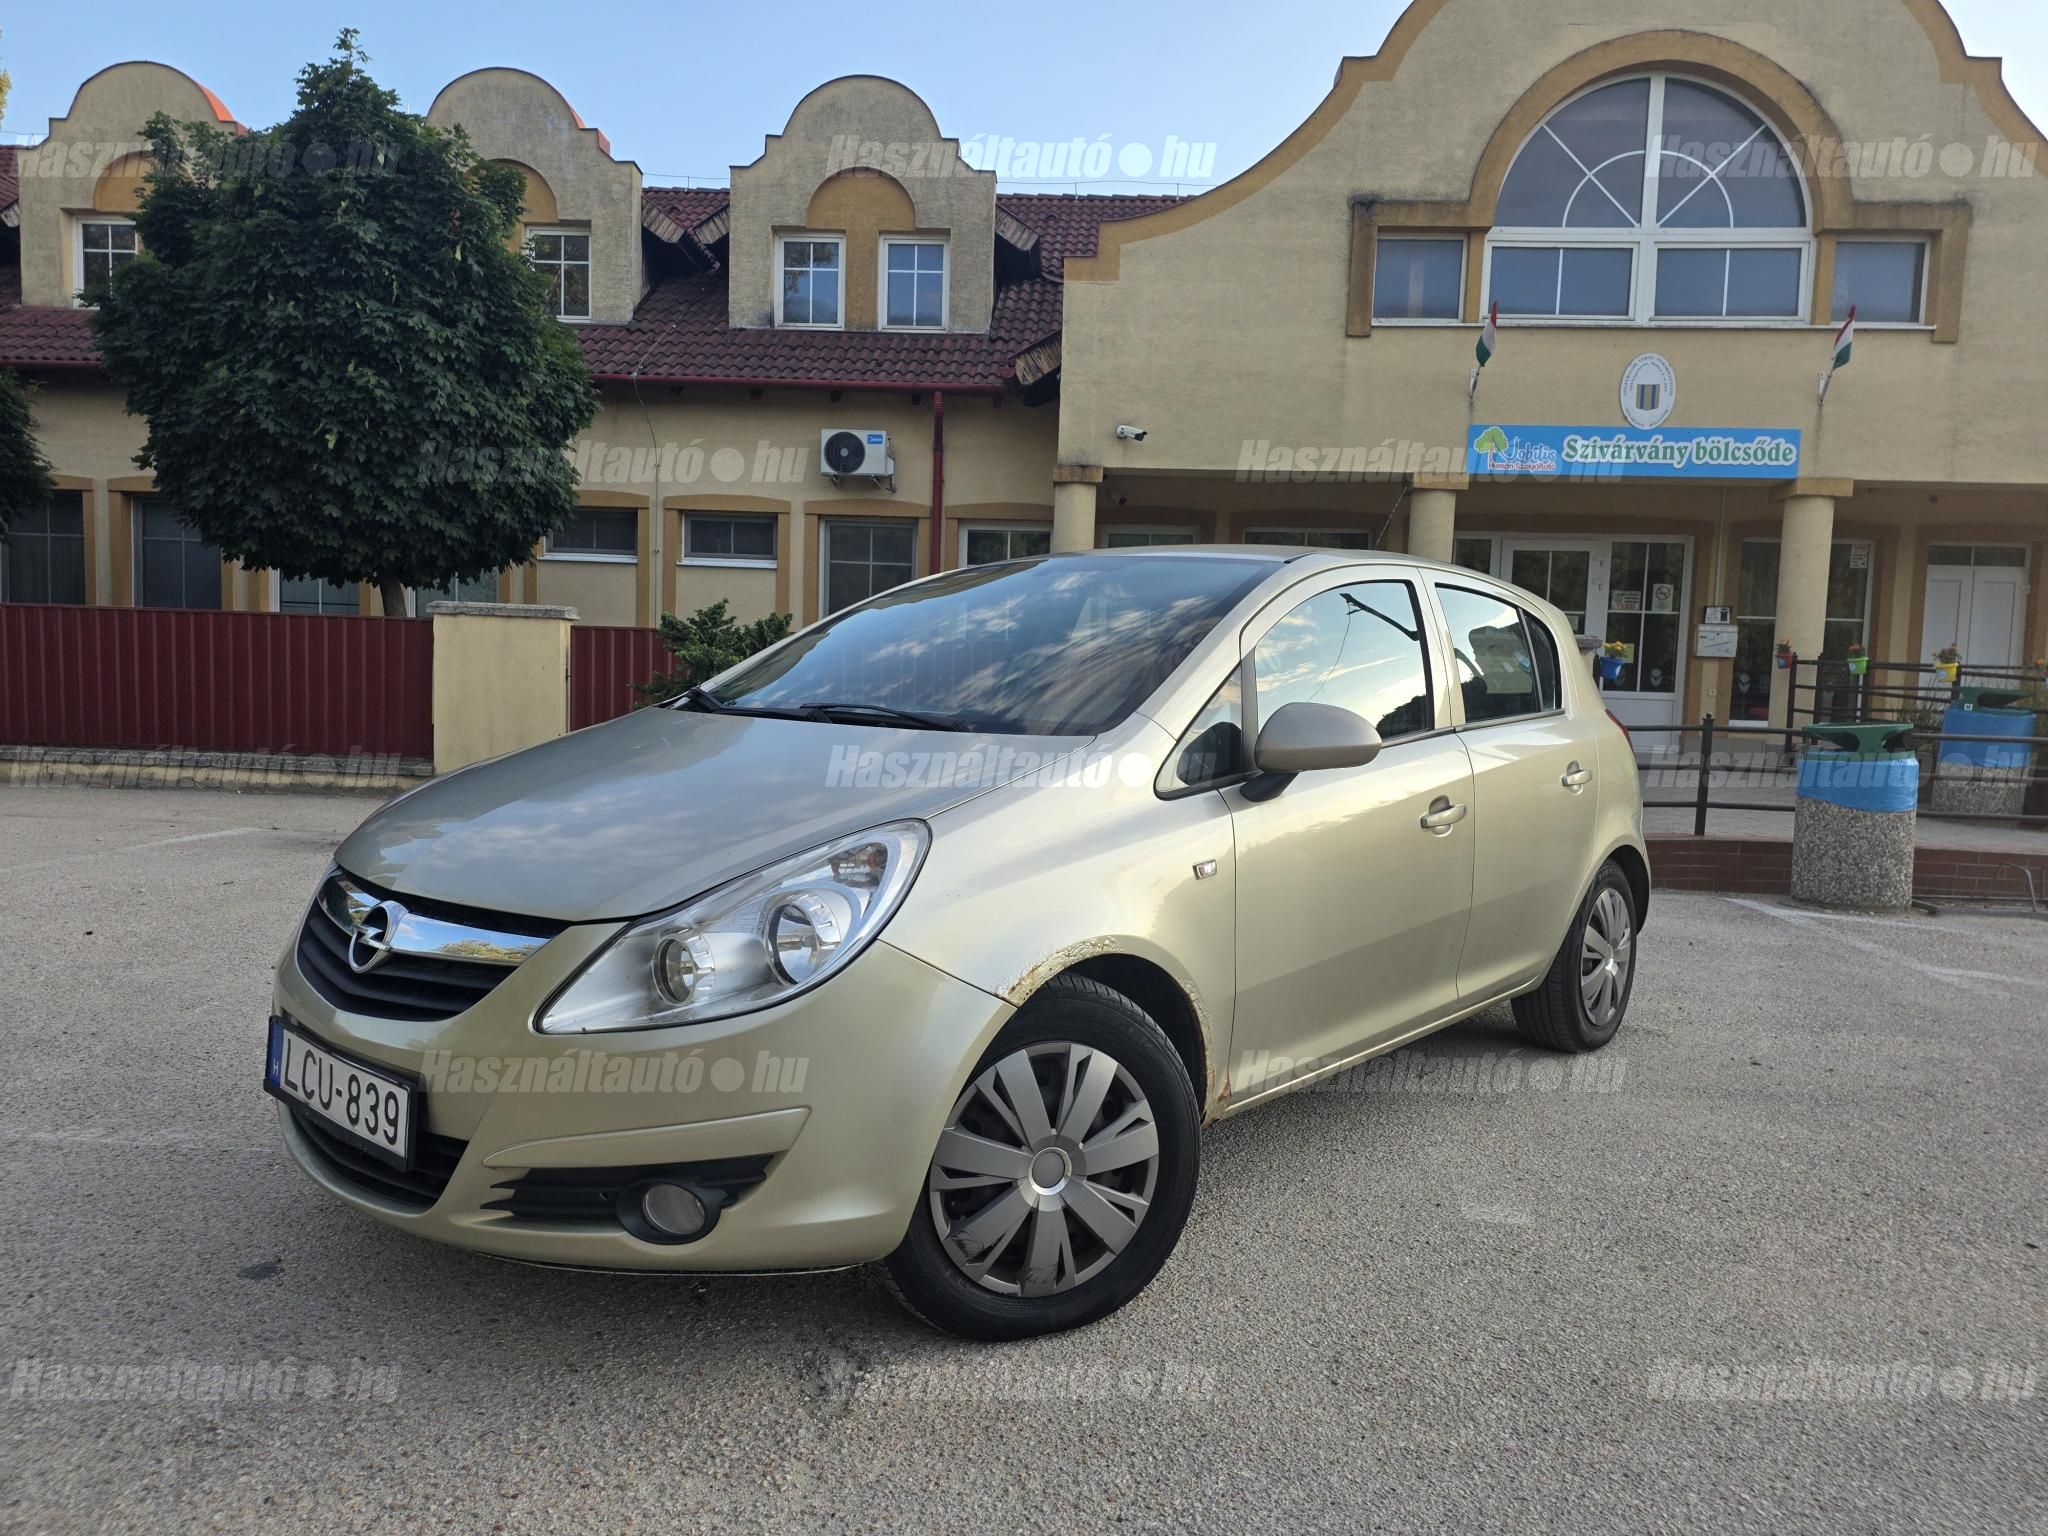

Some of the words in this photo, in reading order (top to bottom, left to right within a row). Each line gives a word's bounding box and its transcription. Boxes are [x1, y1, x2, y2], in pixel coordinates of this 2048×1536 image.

[1563, 437, 1689, 467] Szivárvány
[1694, 436, 1795, 464] bölcsőde
[284, 1037, 400, 1146] LCU-839
